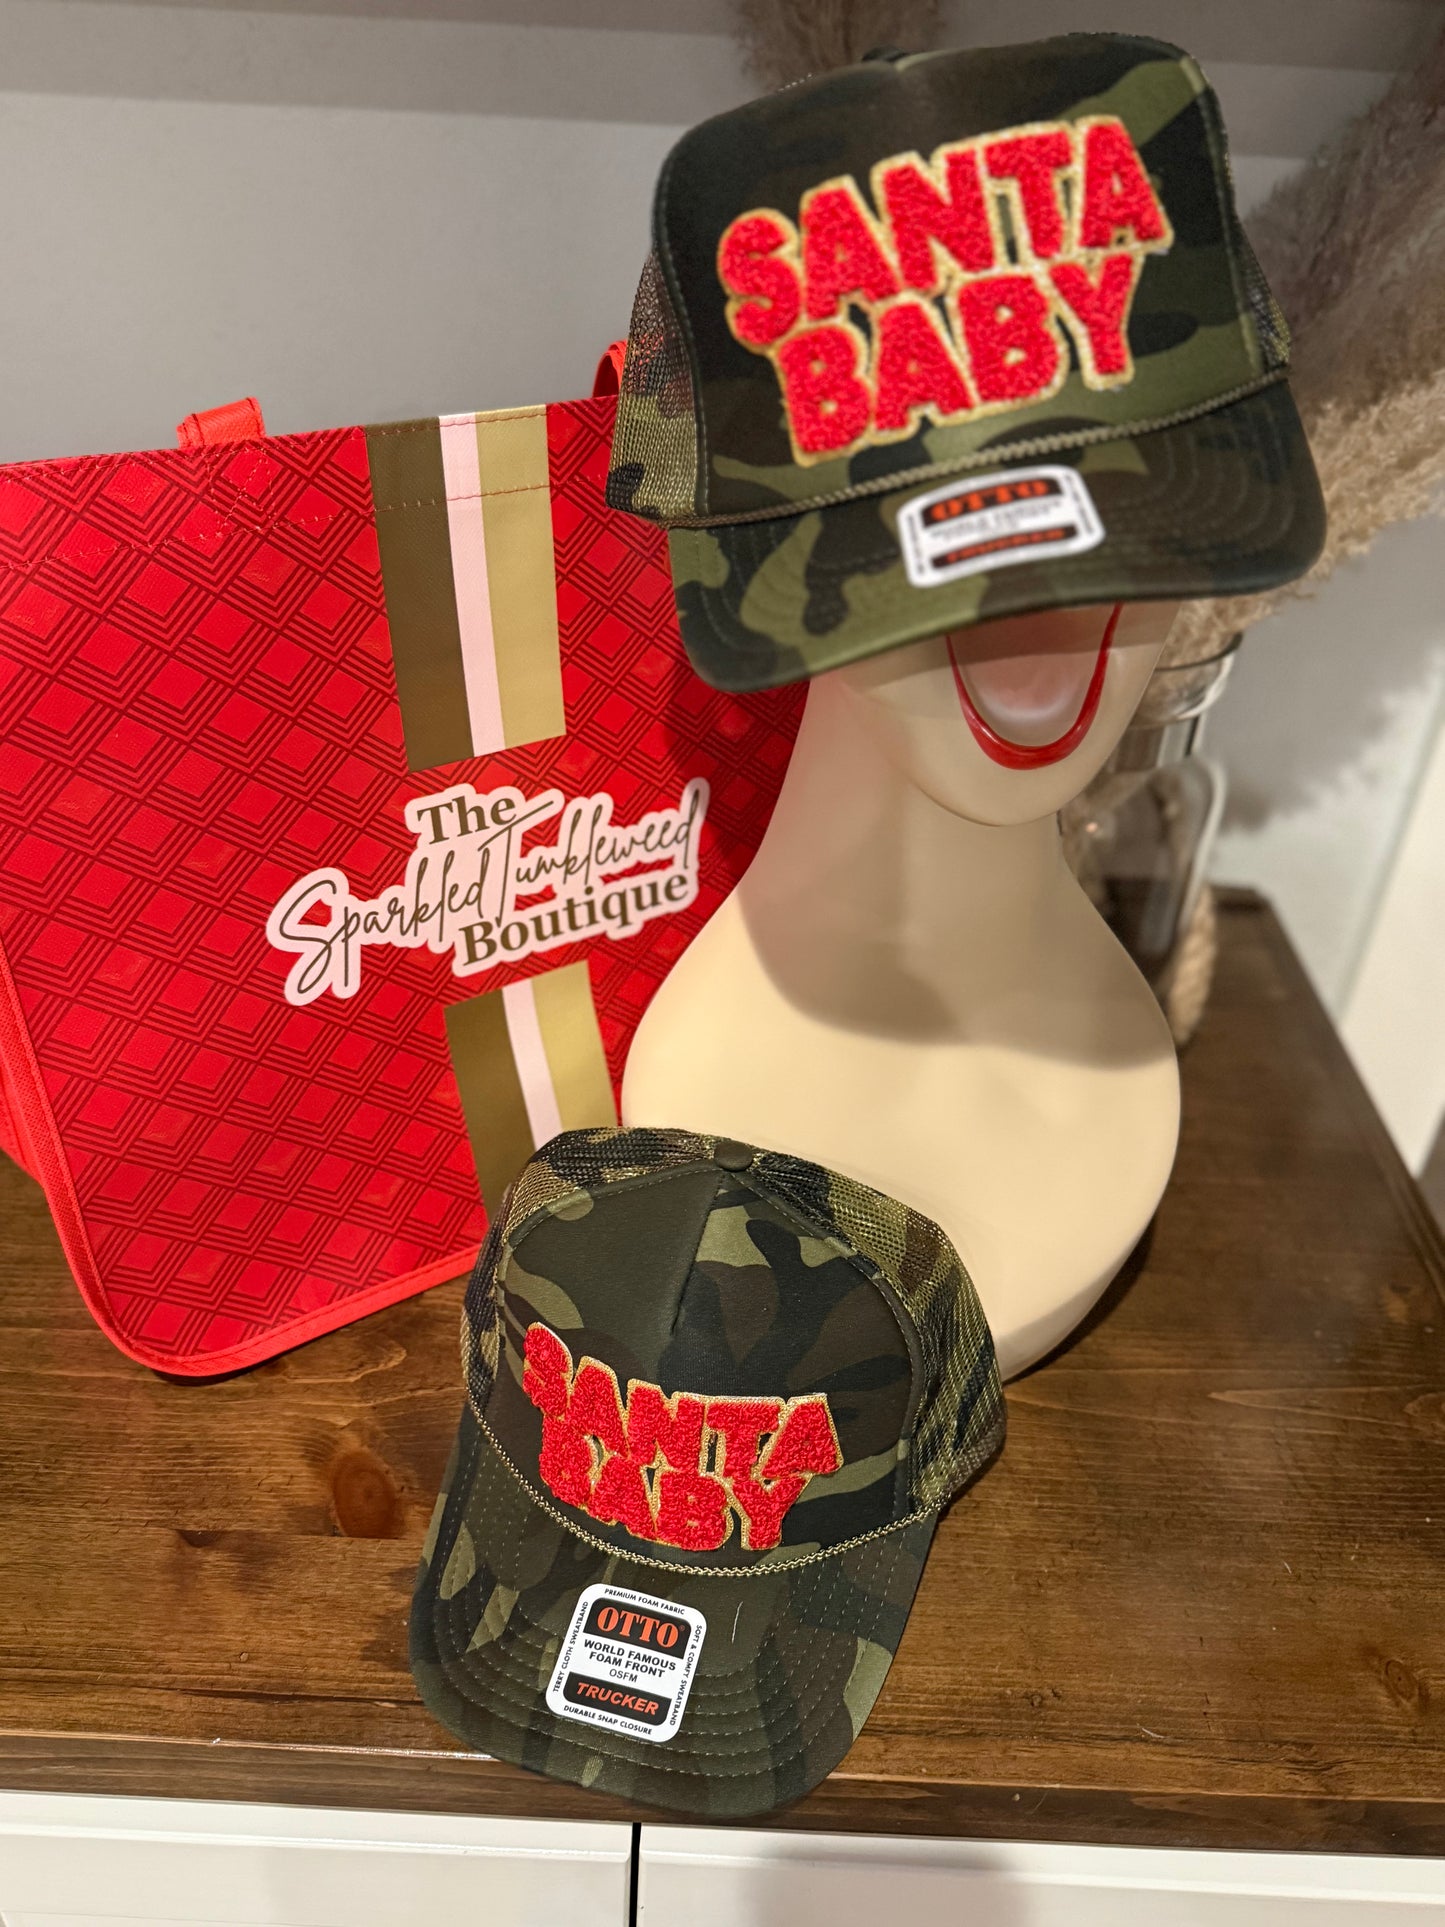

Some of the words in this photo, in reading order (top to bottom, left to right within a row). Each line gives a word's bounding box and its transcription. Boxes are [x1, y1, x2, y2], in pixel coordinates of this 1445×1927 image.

[717, 115, 1173, 353] SANTA
[773, 252, 1144, 467] BABY
[416, 796, 517, 846] The
[279, 848, 490, 994] Sparkled
[478, 788, 700, 927] Tumbleweed
[458, 872, 689, 966] Boutique
[522, 1322, 844, 1481] SANTA
[539, 1416, 813, 1551] BABY
[604, 1588, 637, 1601] PREMIUM
[638, 1596, 659, 1608] FOAM
[660, 1602, 685, 1615] FABRIC
[552, 1670, 565, 1693] TERRY
[561, 1646, 574, 1670] CLOTH
[569, 1601, 589, 1645] SWEATBAND
[597, 1606, 679, 1648] OTTO
[693, 1625, 703, 1643] SOFT
[583, 1638, 625, 1657] WORLD
[627, 1650, 676, 1671] FAMOUS
[589, 1651, 623, 1667] FOAM
[624, 1660, 666, 1678] FRONT
[608, 1668, 638, 1683] OSFM
[685, 1650, 697, 1679] COMFY
[563, 1705, 596, 1719] DURABLE
[597, 1713, 619, 1725] SNAP
[619, 1720, 653, 1735] CLOSURE
[576, 1682, 660, 1716] TRUCKER
[669, 1679, 688, 1726] SWEATBAND
